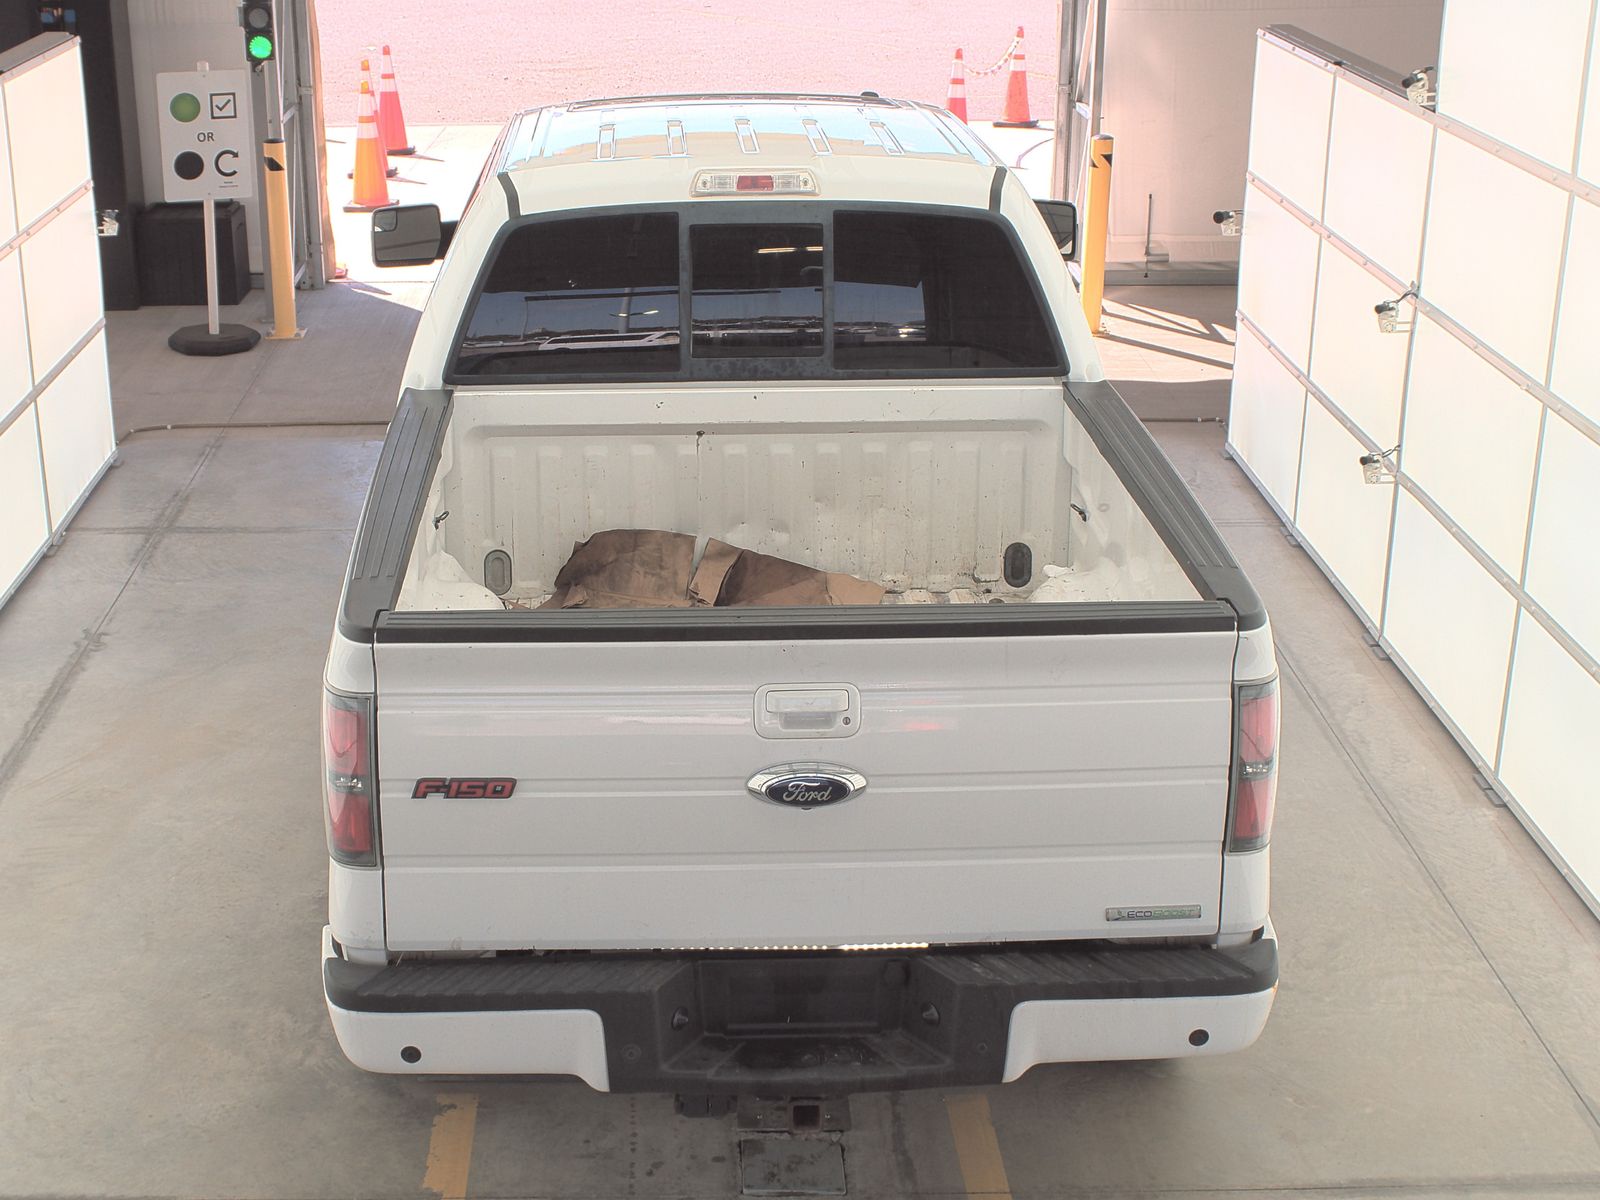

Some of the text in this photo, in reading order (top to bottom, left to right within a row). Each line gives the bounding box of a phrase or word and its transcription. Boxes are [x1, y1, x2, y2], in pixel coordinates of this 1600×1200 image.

[197, 132, 215, 143] OR
[411, 777, 517, 799] F-150
[782, 781, 833, 801] Ford
